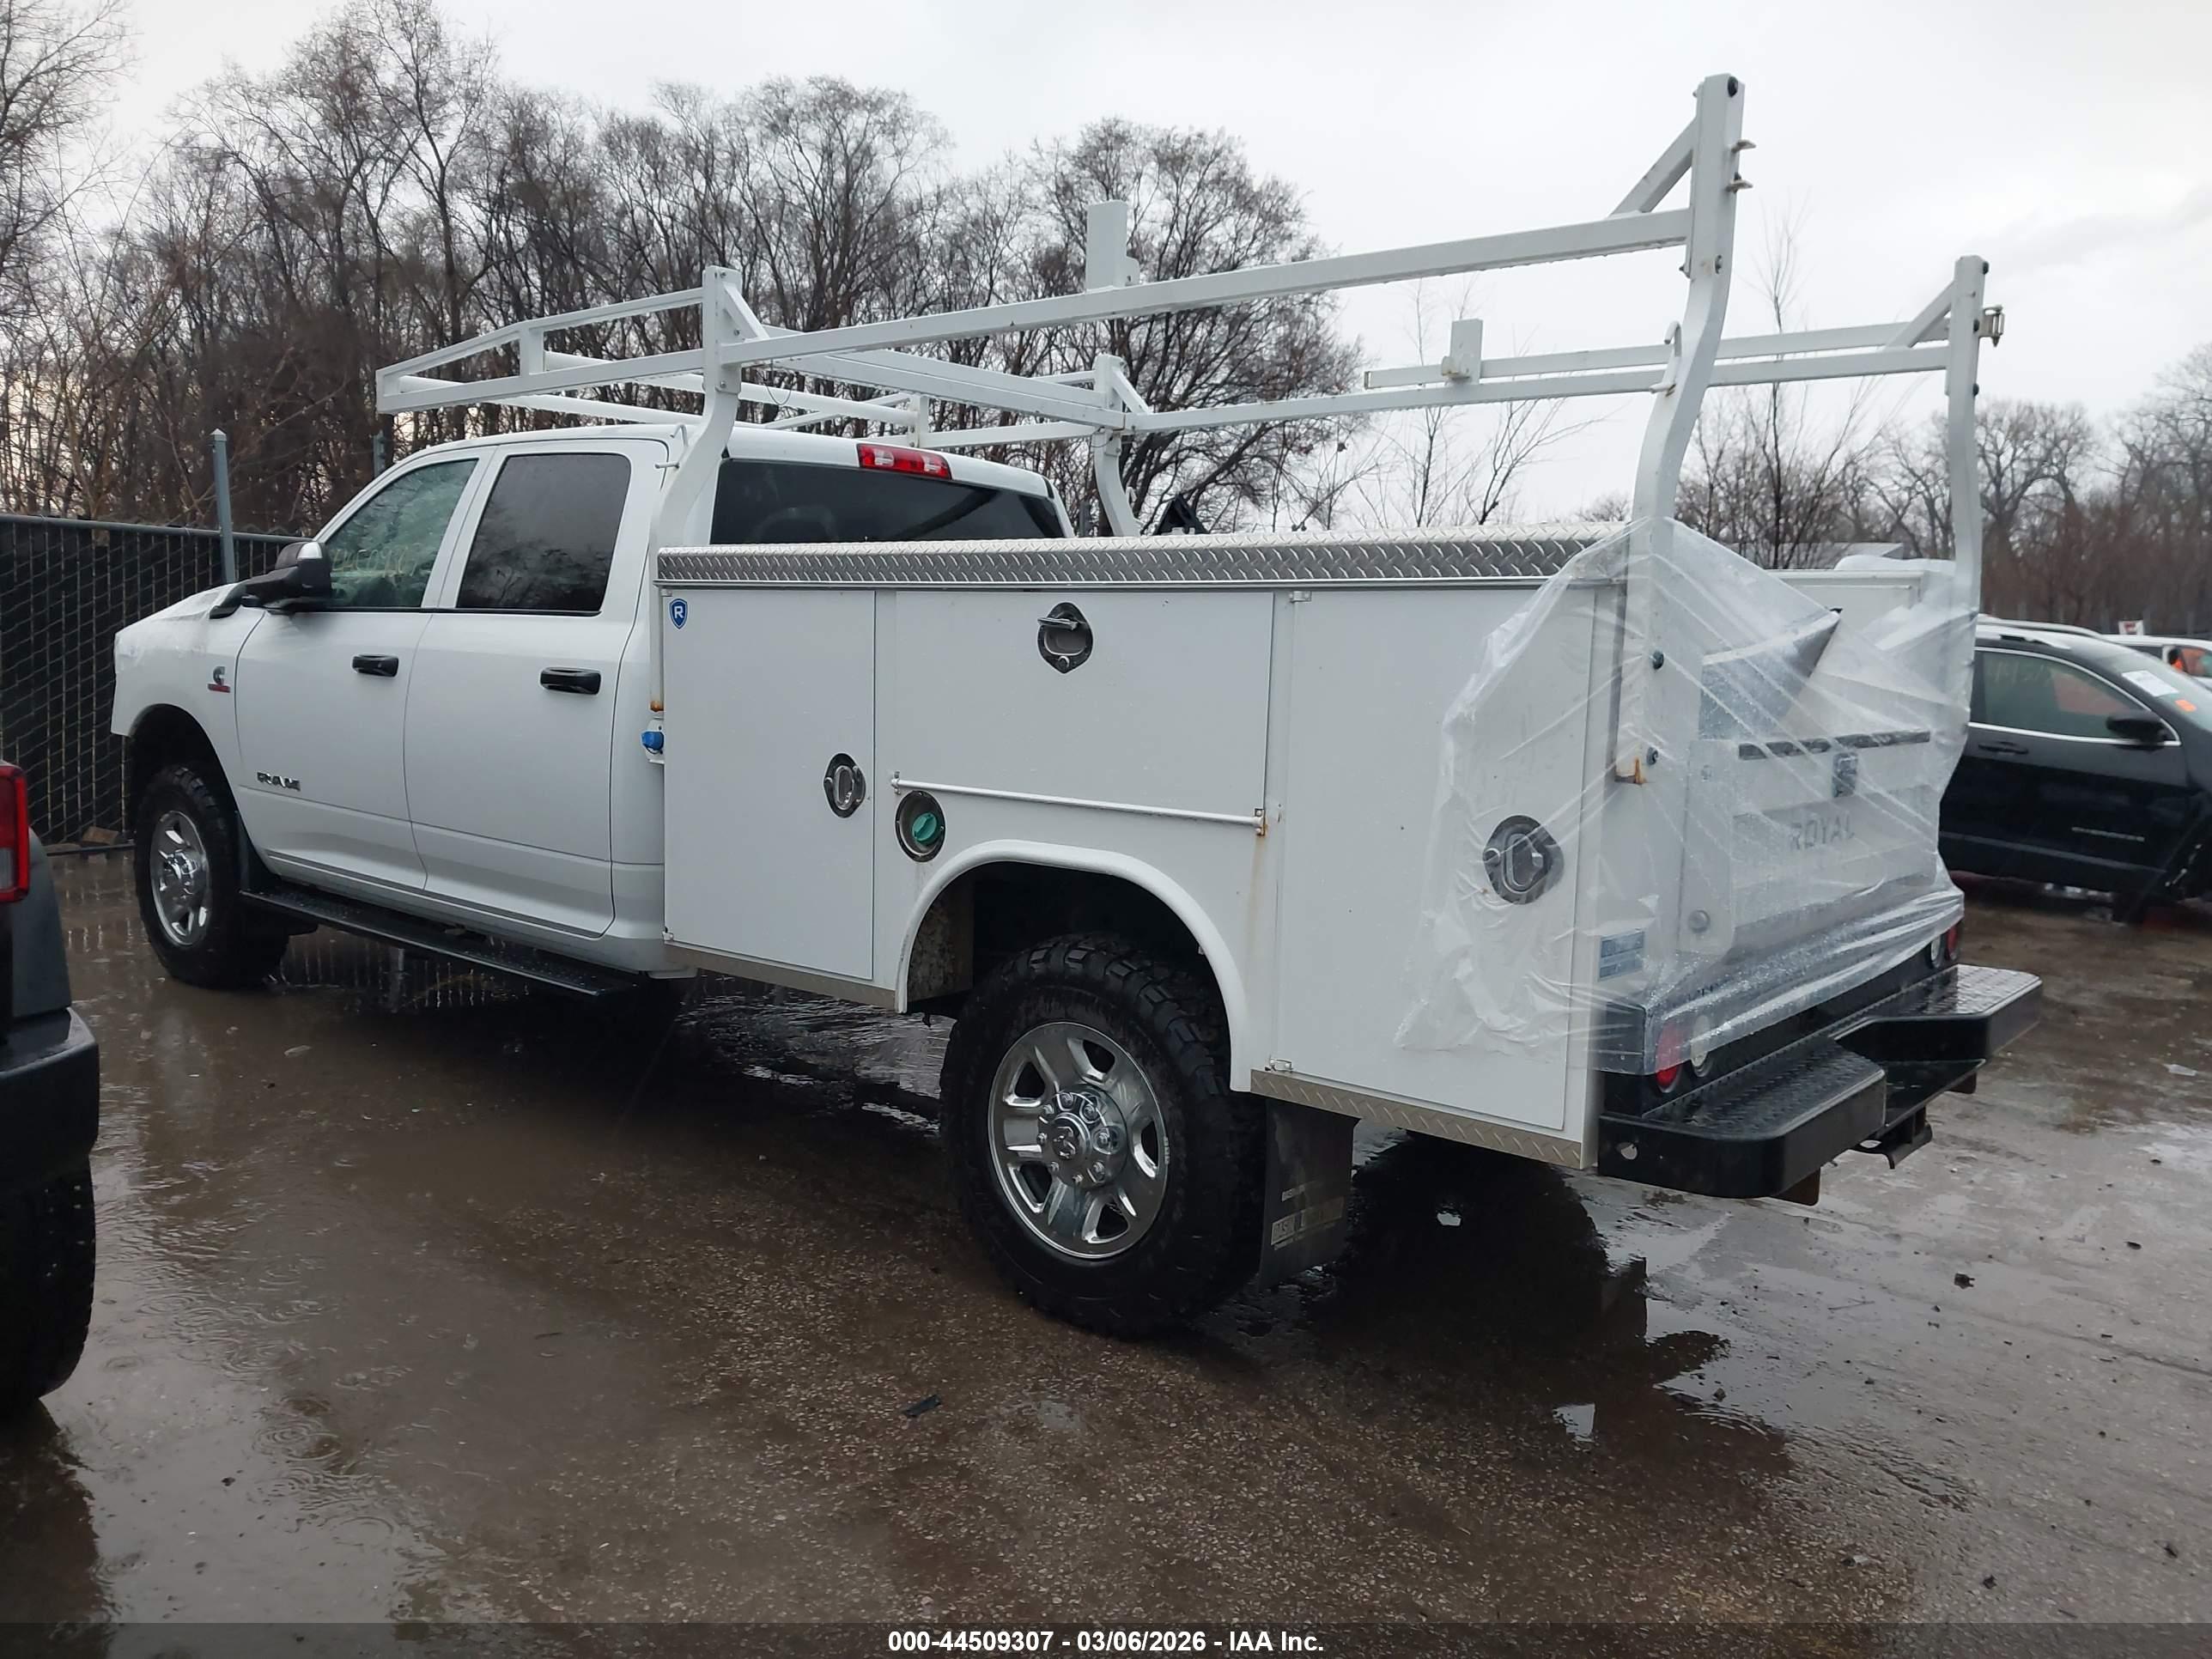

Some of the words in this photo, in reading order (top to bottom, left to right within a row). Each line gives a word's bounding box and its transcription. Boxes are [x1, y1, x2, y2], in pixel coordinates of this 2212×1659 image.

[674, 605, 684, 619] R
[257, 771, 301, 792] RAM
[1789, 813, 1856, 850] ROYAL
